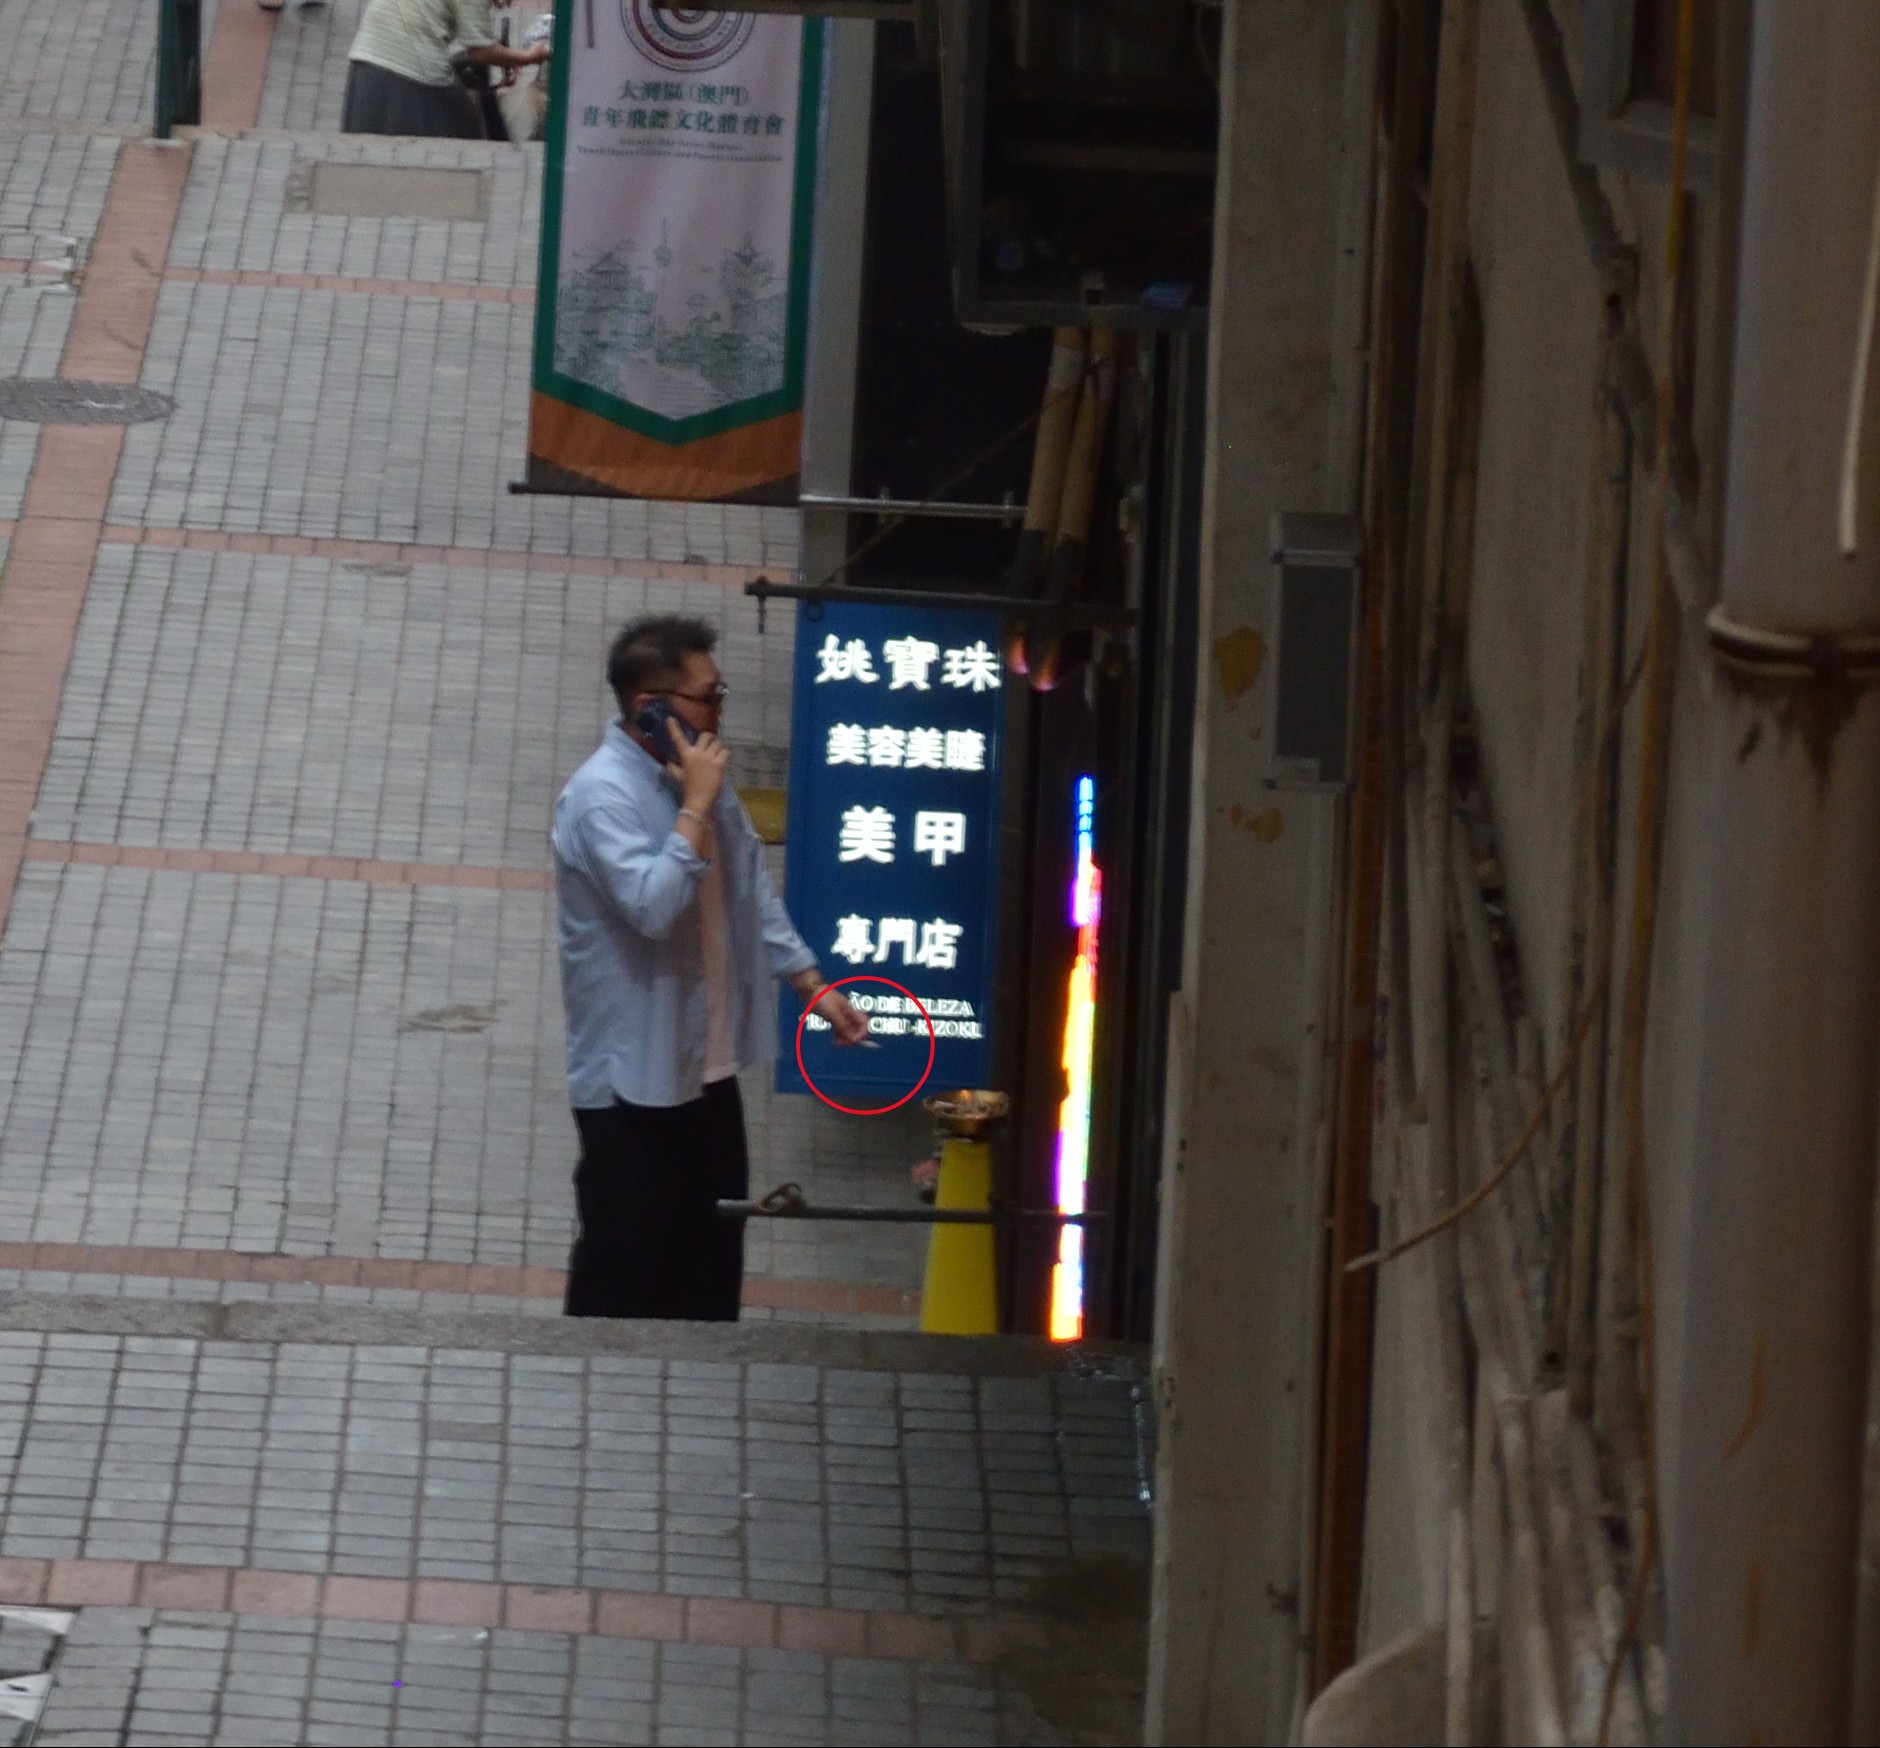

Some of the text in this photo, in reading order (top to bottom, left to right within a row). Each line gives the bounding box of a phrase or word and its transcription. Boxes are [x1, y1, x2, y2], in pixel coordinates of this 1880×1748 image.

[814, 633, 1002, 692] 姚寶珠
[838, 804, 967, 866] 美甲
[830, 913, 964, 969] 專門店
[876, 995, 903, 1014] DE
